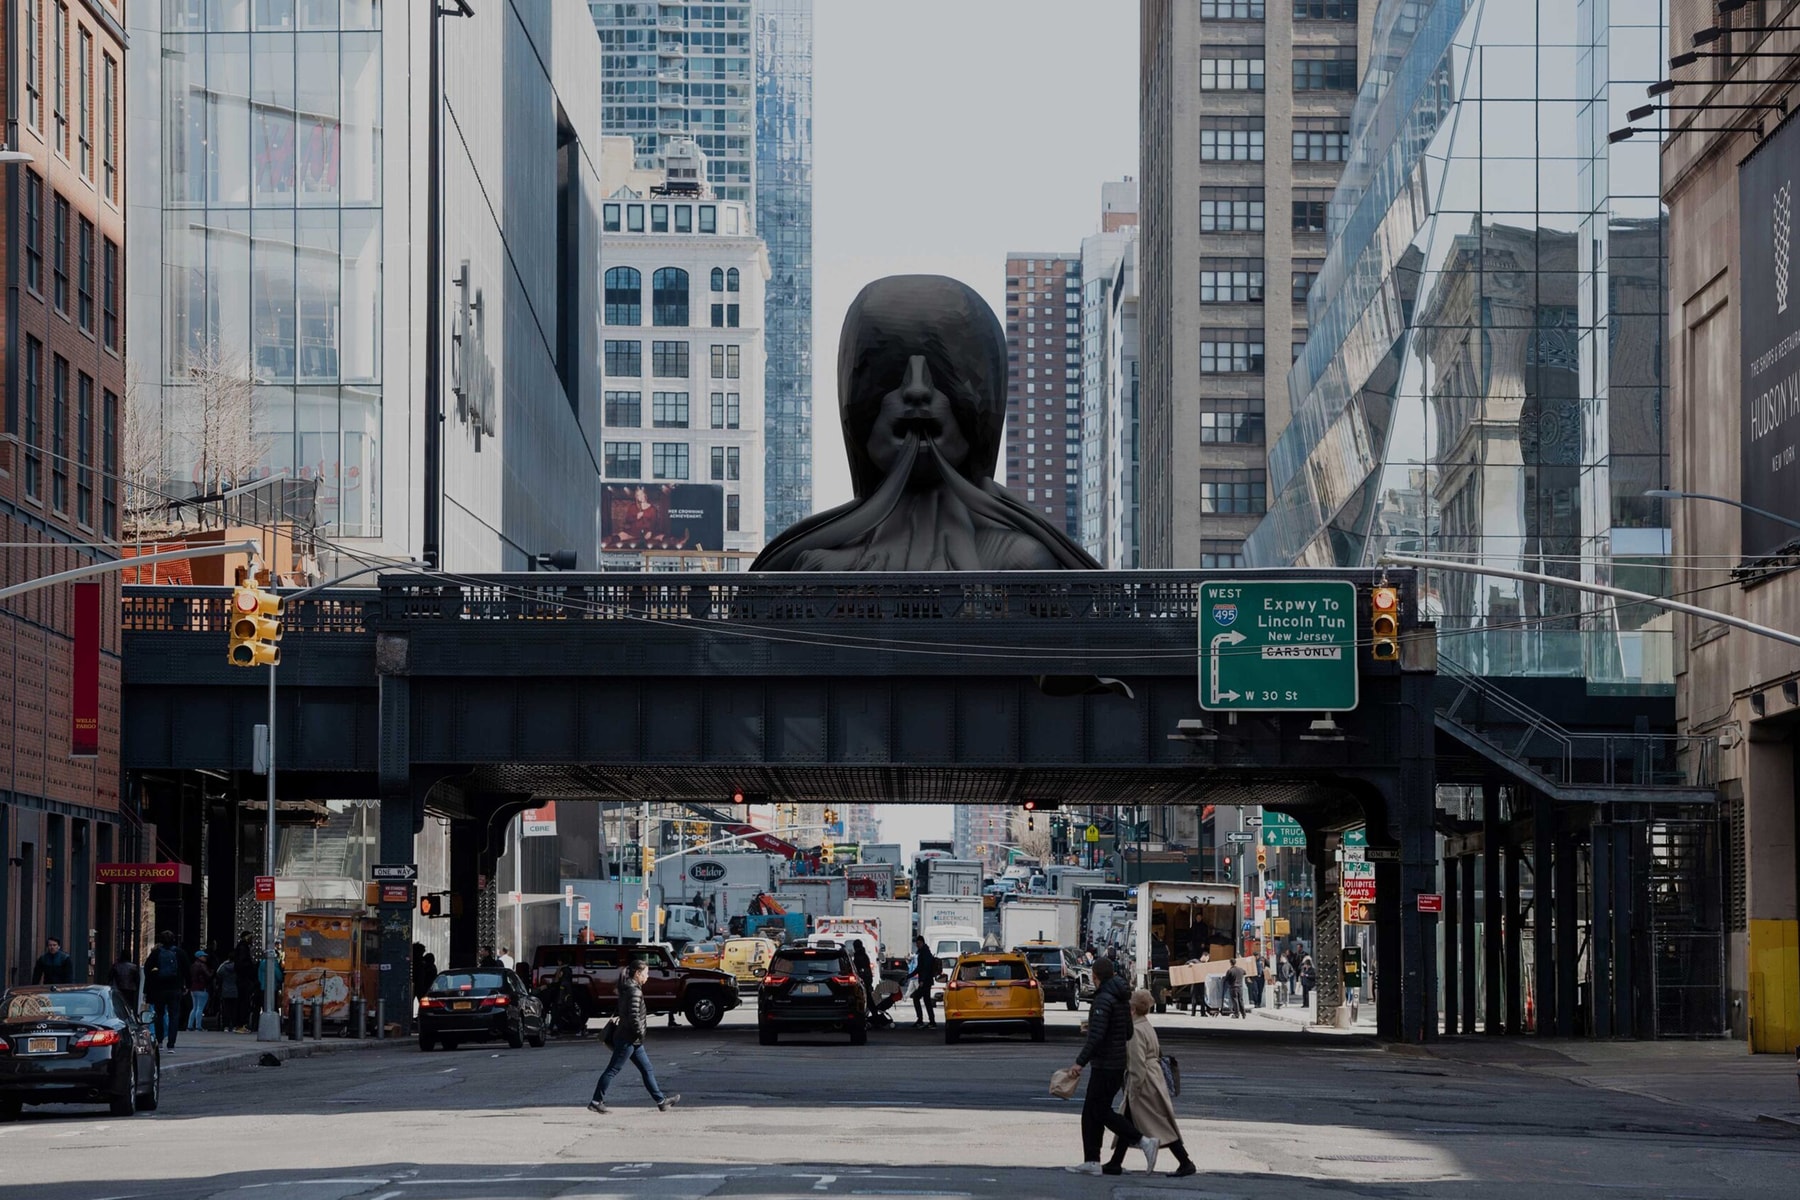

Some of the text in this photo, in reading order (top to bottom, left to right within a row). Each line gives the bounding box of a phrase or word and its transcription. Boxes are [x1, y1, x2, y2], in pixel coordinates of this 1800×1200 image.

[1751, 379, 1787, 442] HUDSON
[1772, 444, 1796, 473] NEW YORK
[1208, 589, 1241, 599] WEST
[1264, 598, 1339, 613] Expwy To
[1215, 610, 1235, 622] 495
[1258, 616, 1346, 628] Lincoln Tun
[1268, 632, 1335, 643] New Jersey
[1266, 647, 1337, 657] CARS ONLY
[1245, 691, 1298, 701] W 30 St
[1283, 837, 1306, 845] BUSE
[100, 868, 175, 877] WELLS FARGO
